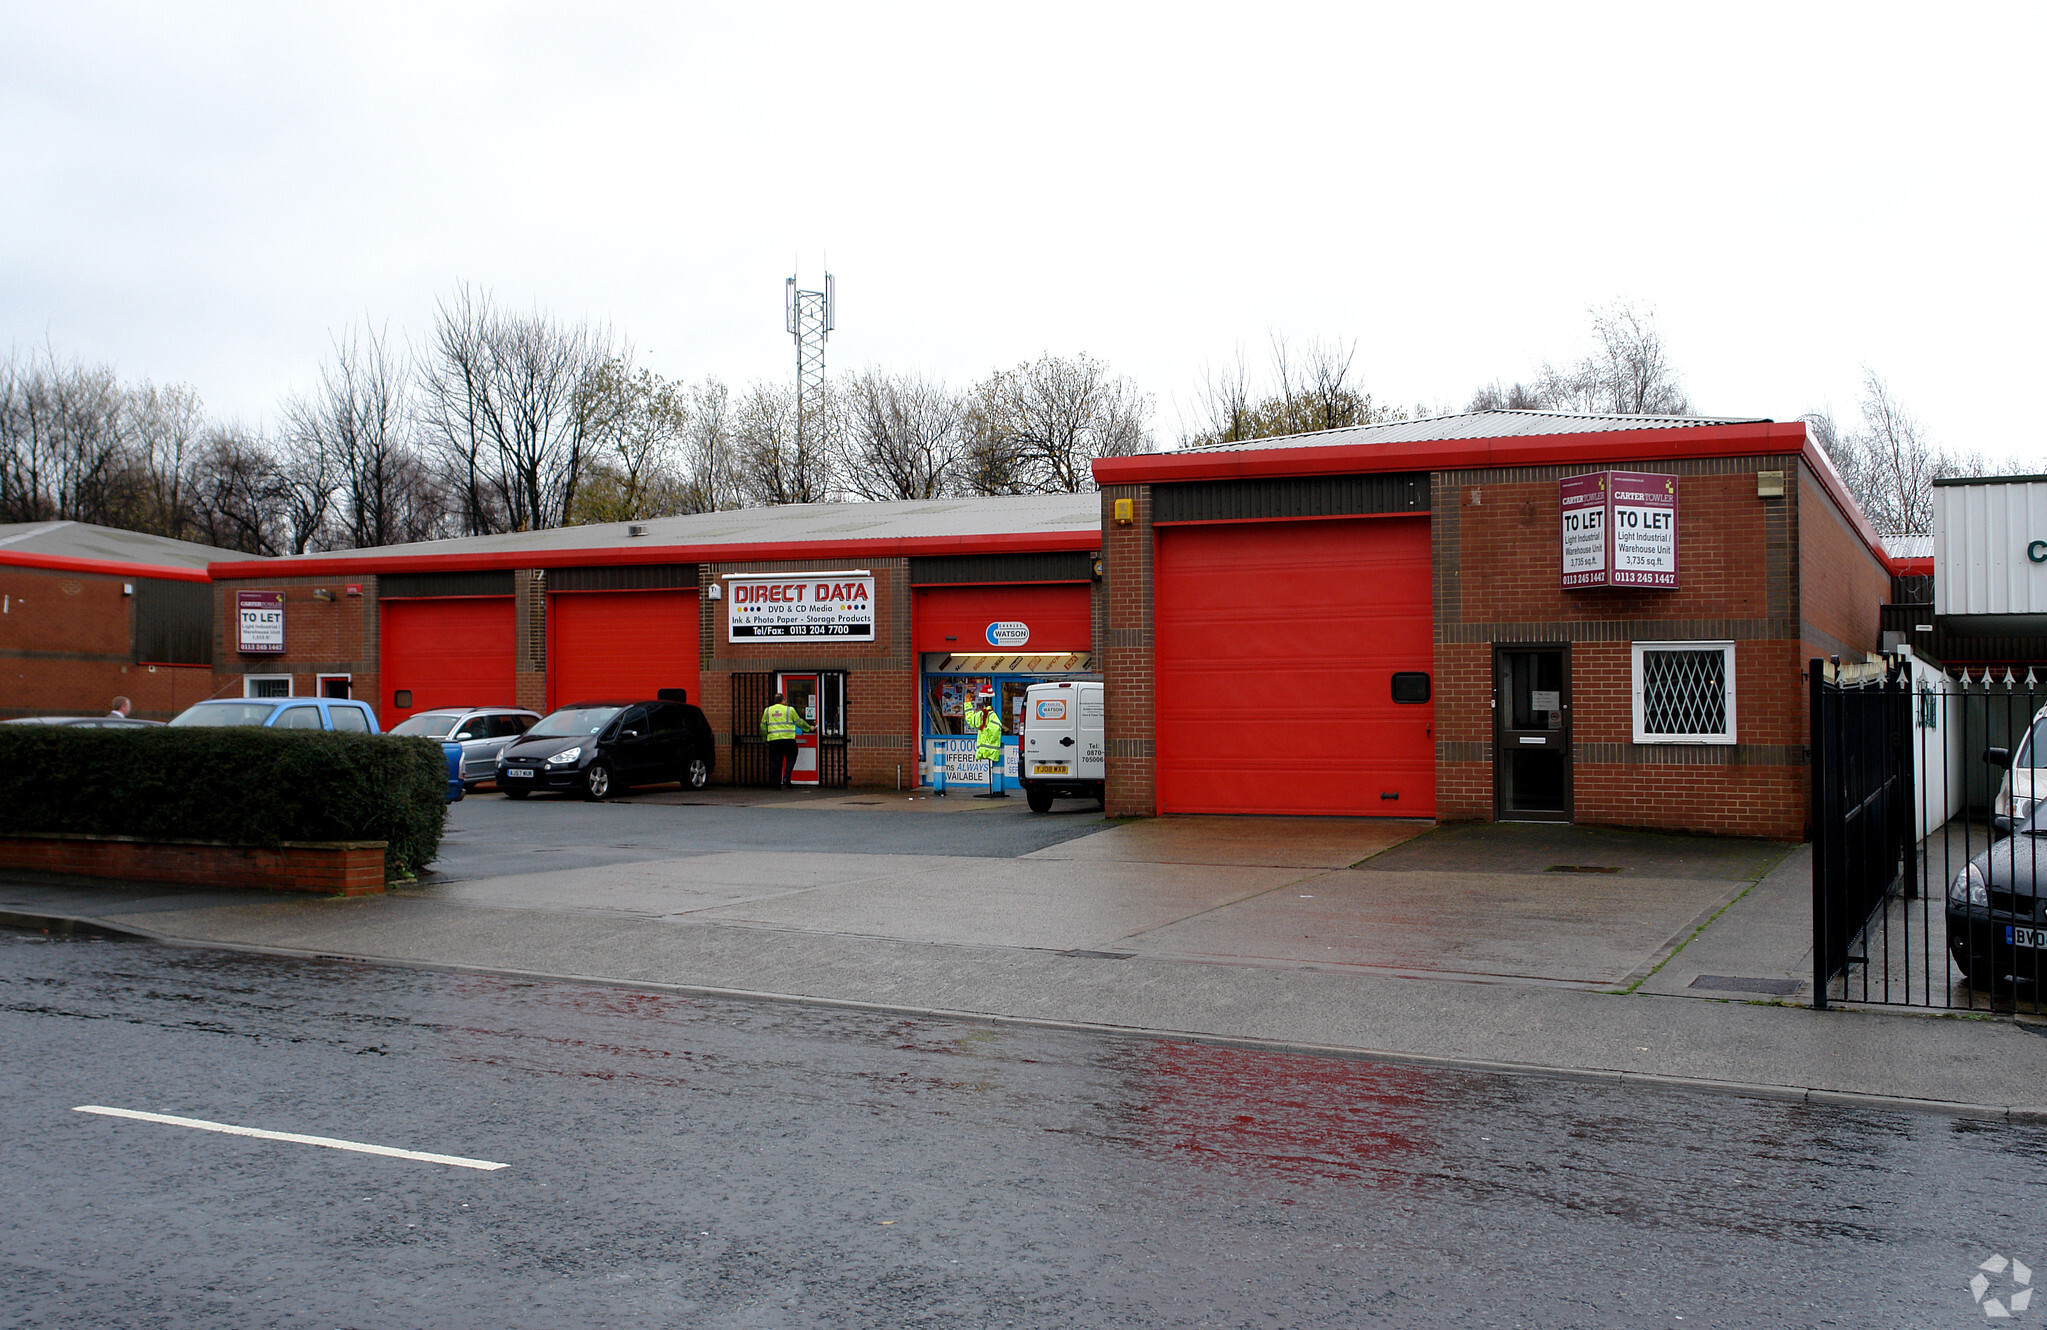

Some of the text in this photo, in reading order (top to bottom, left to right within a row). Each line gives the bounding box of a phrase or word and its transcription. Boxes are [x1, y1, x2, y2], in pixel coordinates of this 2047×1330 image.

[1564, 511, 1603, 532] TO LET
[1618, 510, 1672, 530] TO LET
[1565, 534, 1577, 546] Light
[1578, 532, 1600, 542] Industrial
[1618, 532, 1635, 542] Light
[1636, 532, 1668, 542] Industrial
[1566, 544, 1602, 556] Warehouse Unit
[1618, 544, 1670, 554] Warehouse Unit
[1570, 558, 1584, 567] 3,735
[1626, 556, 1664, 567] 3,735 sq.ft.
[1562, 572, 1605, 585] 0113 245 1447
[1615, 572, 1674, 584] 0113 245 1447
[734, 583, 868, 604] DIRECT DATA
[809, 604, 833, 612] Media
[242, 613, 281, 622] TO LET
[777, 616, 798, 624] Paper
[806, 615, 835, 624] Storage
[838, 614, 871, 622] Products
[753, 625, 849, 636] Tel/Fax: 0113 204 7700
[946, 754, 982, 762] IFFEREN
[957, 763, 988, 772] ALWAYS
[946, 772, 983, 780] VAILABLE
